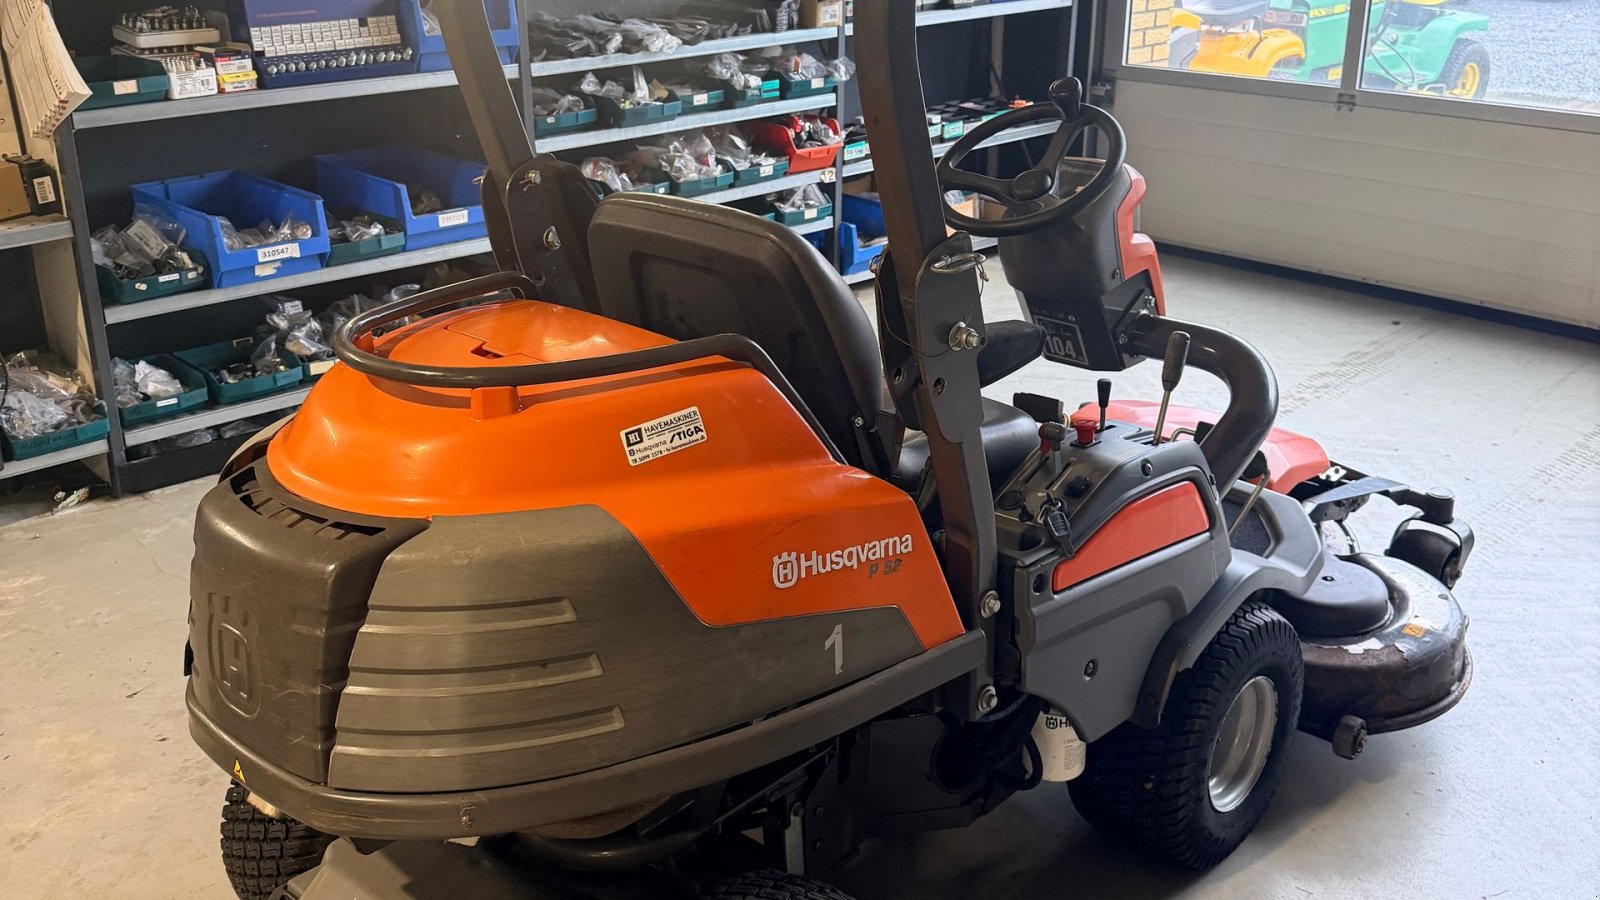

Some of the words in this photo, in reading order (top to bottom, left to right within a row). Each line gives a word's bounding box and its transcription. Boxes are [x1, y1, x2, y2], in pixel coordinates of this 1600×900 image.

[262, 247, 289, 258] 310547
[1046, 335, 1077, 358] 104
[644, 410, 699, 434] HAVEMASKINER
[635, 440, 667, 454] Husqvarna
[800, 533, 913, 578] Husqvarna
[882, 558, 903, 576] 52
[824, 623, 844, 675] 1
